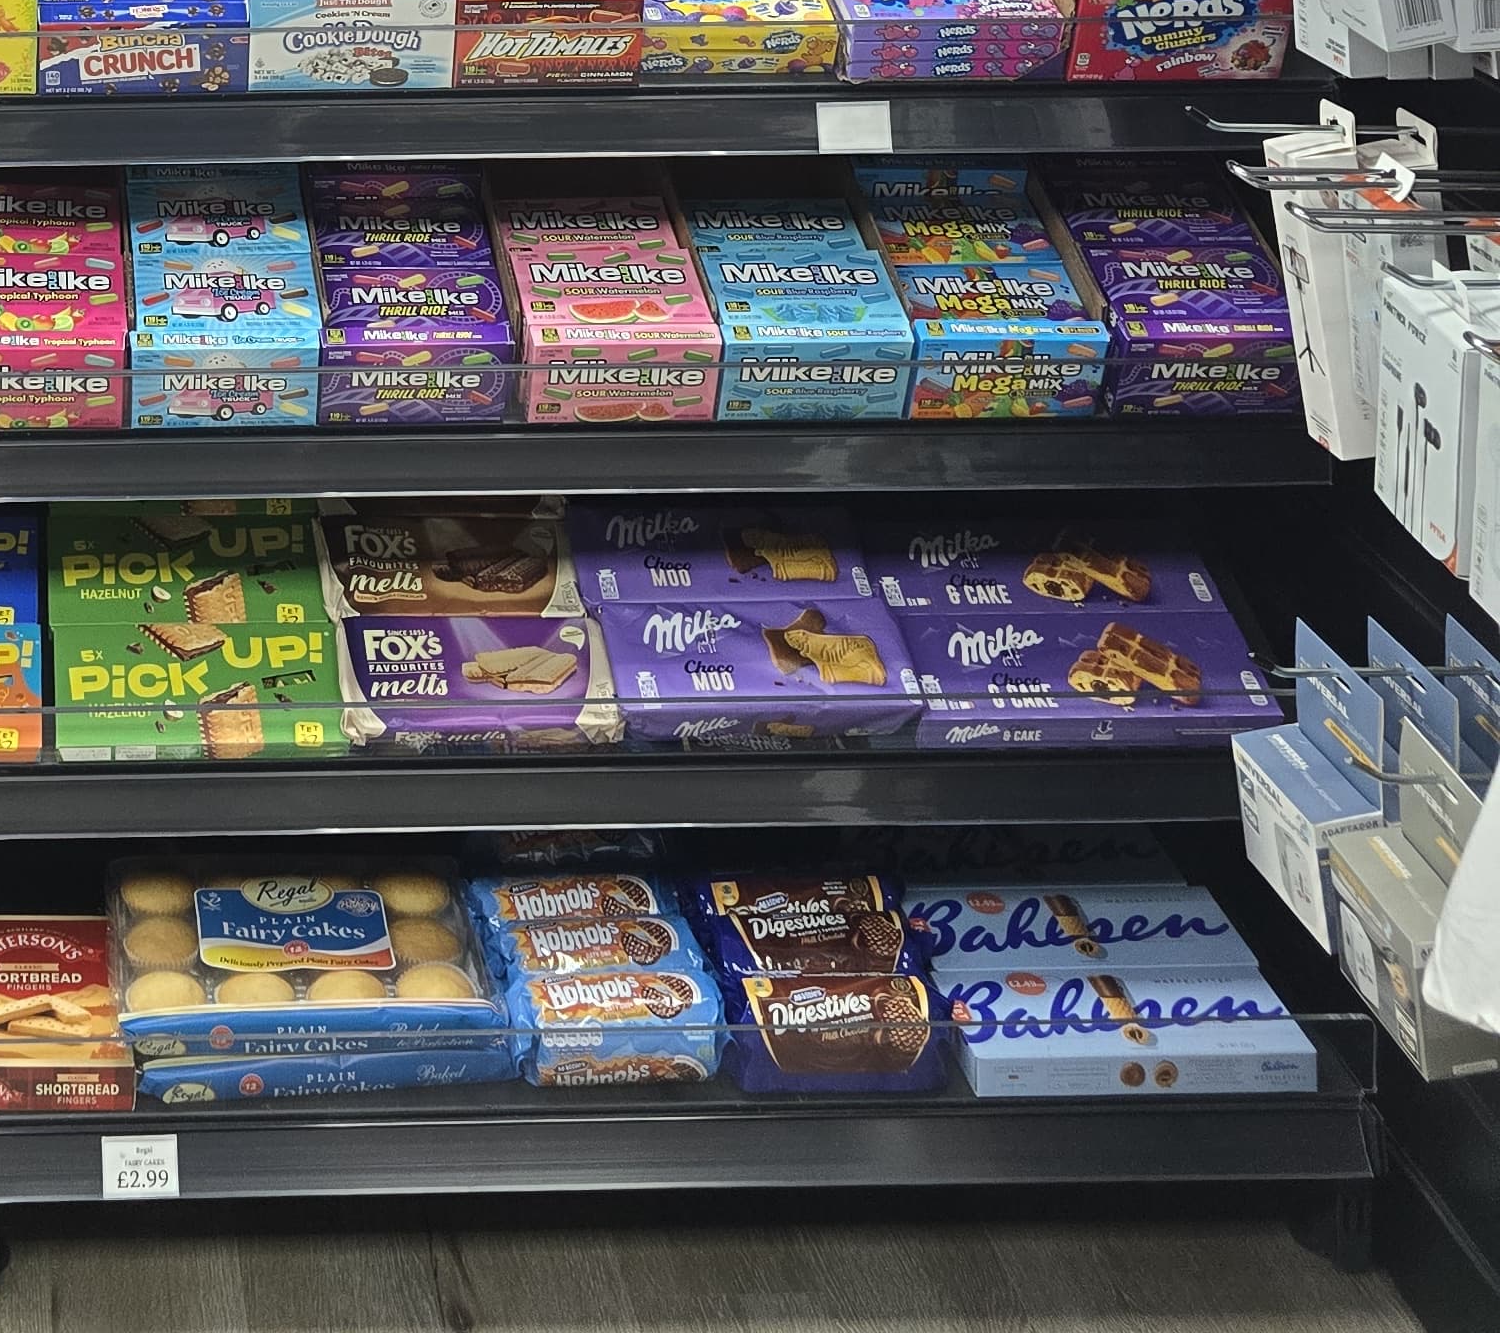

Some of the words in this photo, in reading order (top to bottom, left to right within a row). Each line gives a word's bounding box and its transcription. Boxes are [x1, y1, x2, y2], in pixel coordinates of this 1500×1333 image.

[100, 32, 183, 49] Buncha
[580, 70, 633, 78] CINNAMON
[1117, 209, 1154, 218] THRILL
[1156, 209, 1184, 218] RIDE
[32, 292, 78, 301] Typhoon
[564, 287, 597, 296] SOUR
[598, 287, 661, 295] Watermelon
[937, 290, 1011, 313] Mega
[80, 588, 143, 600] HAZELNUT
[966, 584, 1012, 603] CAKE
[369, 661, 444, 673] FAVOURITES
[369, 673, 448, 698] melts
[692, 671, 735, 691] MOO
[255, 879, 317, 907] Regal
[260, 916, 316, 927] PLAIN
[222, 921, 286, 943] Fairy
[291, 921, 366, 940] Cakes
[219, 956, 264, 968] Deliciously
[545, 973, 639, 1008] Hobnobs
[769, 993, 870, 1029] Digestives
[117, 1170, 169, 1190] £2.99
